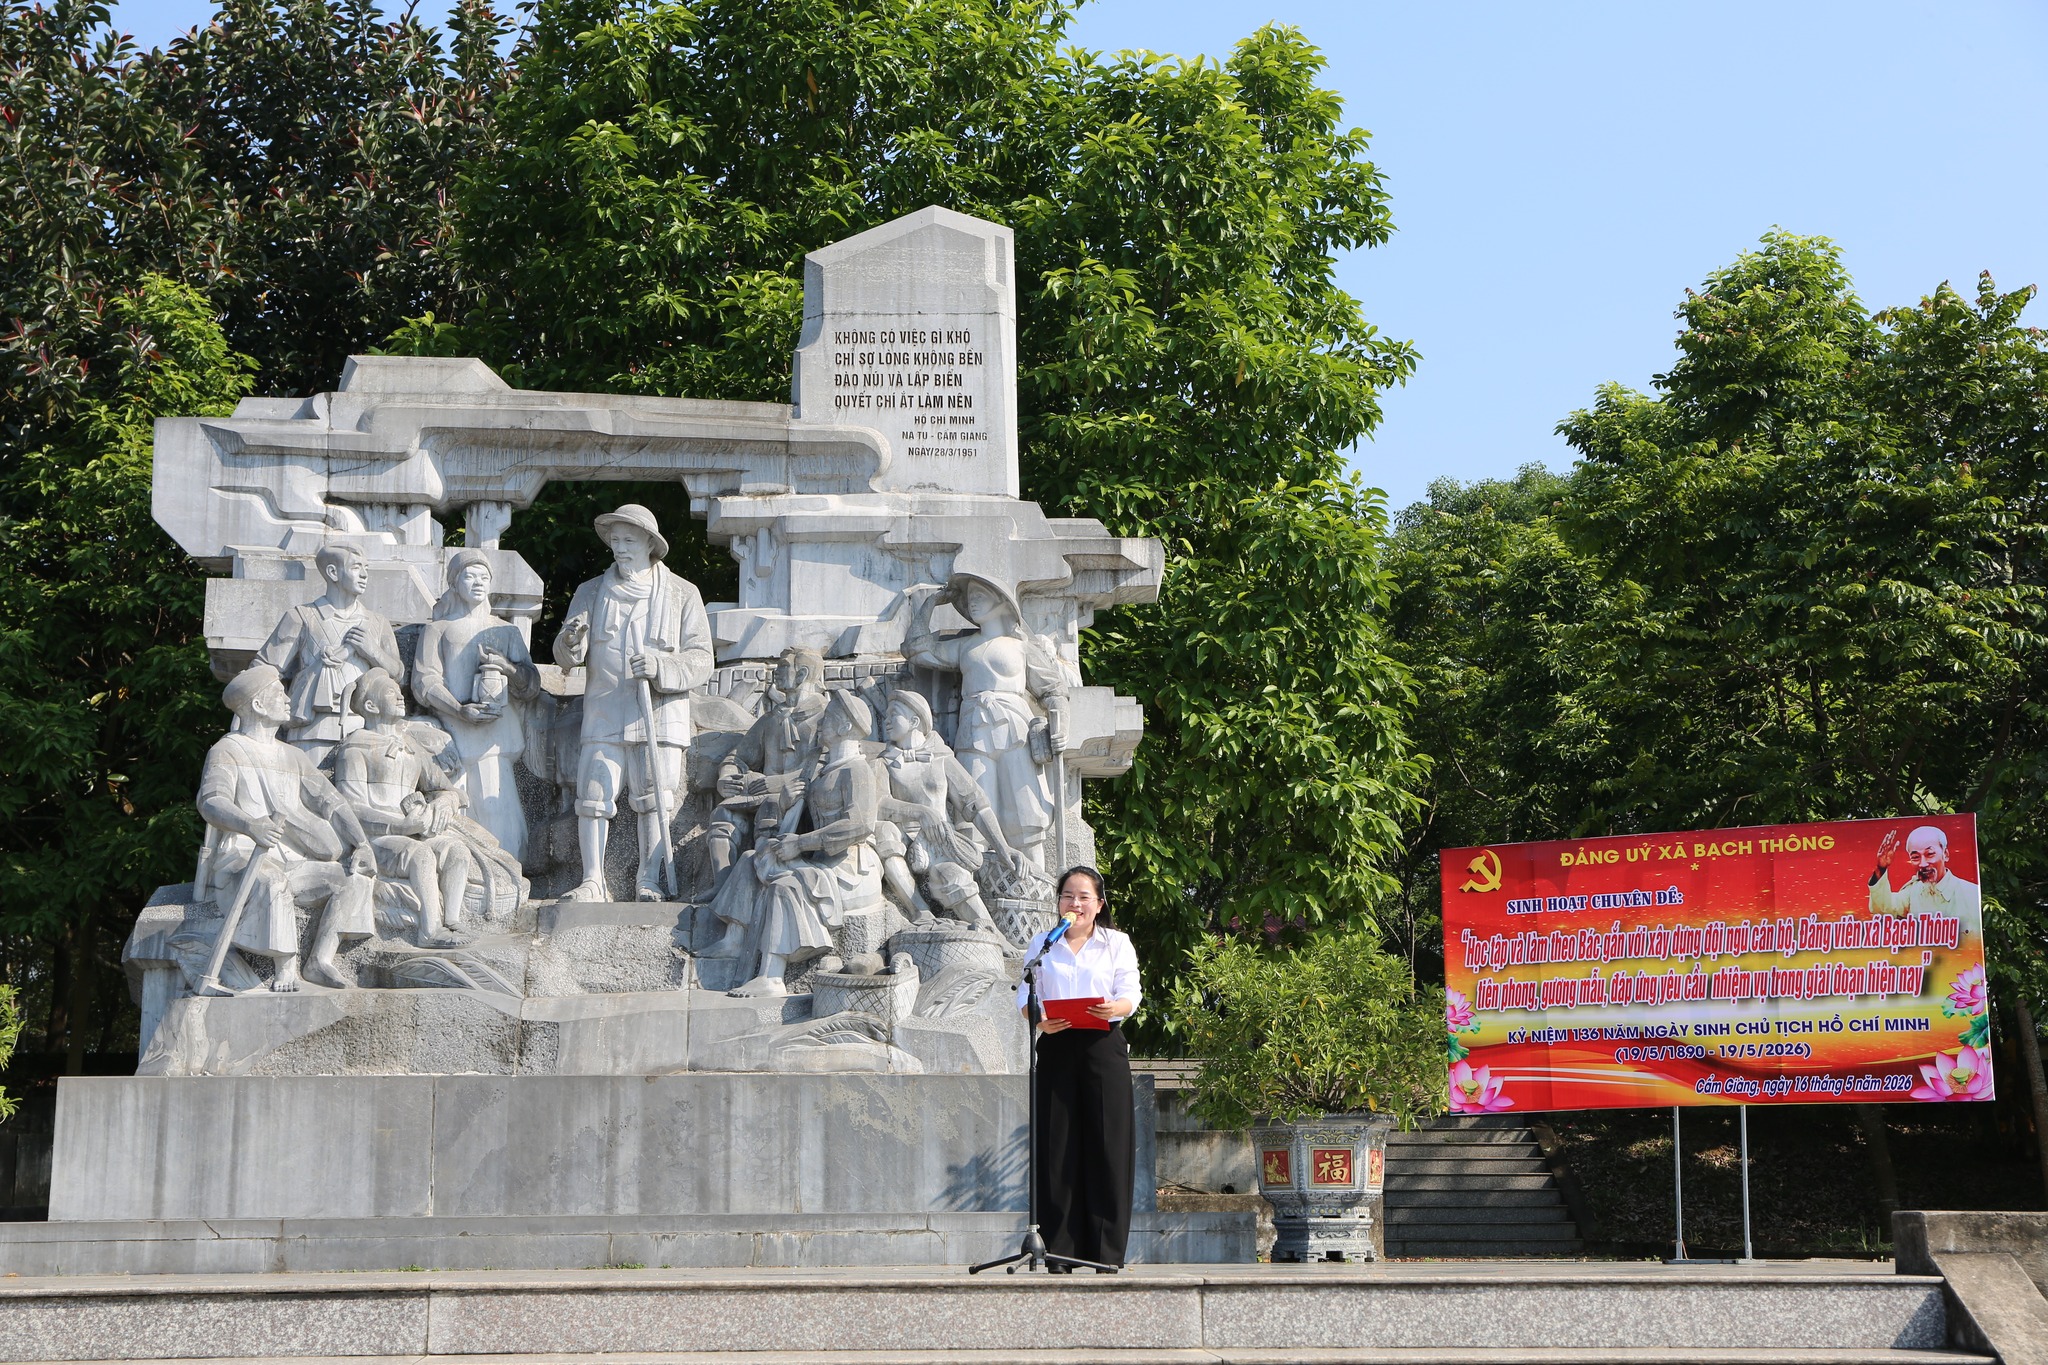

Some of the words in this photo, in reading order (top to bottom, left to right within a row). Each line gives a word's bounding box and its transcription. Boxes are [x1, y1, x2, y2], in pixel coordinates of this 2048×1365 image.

[835, 328, 876, 344] KHÔNG
[880, 328, 896, 344] CÓ
[900, 328, 926, 346] VIỆC
[931, 328, 942, 344] GÌ
[946, 328, 970, 344] KHÓ
[835, 348, 854, 366] CHỈ
[859, 351, 875, 369] SỢ
[879, 349, 910, 366] LÒNG
[914, 349, 954, 366] KHÔNG
[959, 348, 982, 366] BỀN
[834, 371, 858, 386] ĐÀO
[864, 371, 884, 386] NÚI
[888, 371, 903, 386] VÀ
[908, 369, 929, 386] LẤP
[934, 369, 962, 386] BIỂN
[835, 390, 872, 409] QUYẾT
[876, 392, 896, 408] CHÍ
[918, 392, 943, 408] LÀM
[948, 392, 972, 408] NÊN
[930, 414, 946, 424] CHÍ
[950, 416, 975, 424] MINH
[1560, 847, 1620, 866] ĐẢNG
[1626, 842, 1652, 862] UỶ
[1658, 842, 1688, 860] XÃ
[1694, 840, 1752, 860] BẠCH
[1759, 834, 1835, 854] THÔNG
[1507, 899, 1542, 914] SINH
[1547, 896, 1587, 912] HOẠT
[1592, 890, 1652, 908] CHUYÊN
[1490, 934, 1508, 971] tập
[1510, 932, 1524, 965] và
[1526, 932, 1548, 963] làm
[1550, 931, 1576, 962] theo
[1578, 928, 1600, 960] Bác
[1602, 921, 1625, 962] gắn
[1628, 926, 1647, 958] với
[1648, 924, 1670, 960] xây
[1672, 924, 1701, 962] dựng
[1704, 922, 1725, 960] đội
[1726, 920, 1750, 957] ngũ
[1752, 918, 1775, 952] cán
[1776, 918, 1796, 958] bộ,
[1799, 913, 1832, 952] Đảng
[1834, 915, 1862, 949] viên
[1863, 915, 1882, 948] xã
[1882, 914, 1916, 954] Bạch
[1919, 912, 1958, 949] Thông
[1476, 978, 1500, 1010] tiên
[1500, 977, 1539, 1012] phong,
[1540, 978, 1578, 1010] gương
[1579, 968, 1608, 1006] mẫu,
[1610, 970, 1634, 1006] đáp
[1634, 970, 1658, 1006] ứng
[1659, 968, 1682, 1004] yêu
[1684, 963, 1708, 1000] cầu
[1712, 966, 1751, 1005] nhiệm
[1752, 971, 1770, 1004] vụ
[1770, 967, 1804, 1000] trong
[1805, 962, 1832, 1000] giai
[1833, 962, 1866, 1001] đoạn
[1867, 961, 1896, 1000] hiện
[1508, 1027, 1526, 1044] KỶ
[1531, 1027, 1568, 1046] NIỆM
[1572, 1028, 1600, 1041] 136
[1604, 1024, 1640, 1040] NĂM
[1644, 1022, 1690, 1038] NGÀY
[1694, 1022, 1730, 1036] SINH
[1735, 1018, 1770, 1035] CHỦ
[1775, 1020, 1813, 1036] TỊCH
[1818, 1014, 1844, 1033] HỒ
[1848, 1016, 1880, 1032] CHÍ
[1884, 1017, 1930, 1032] MINH
[1614, 1045, 1705, 1064] (19/5/1890
[1719, 1043, 1812, 1059] 19/5/2026)
[1696, 1074, 1722, 1095] Cẩm
[1724, 1077, 1760, 1096] Giàng,
[1762, 1078, 1793, 1097] ngày
[1794, 1077, 1808, 1092] 16
[1810, 1075, 1844, 1096] tháng
[1845, 1076, 1854, 1092] 5
[1854, 1075, 1882, 1092] năm
[1884, 1075, 1913, 1092] 2026
[1318, 1152, 1348, 1182] 福
